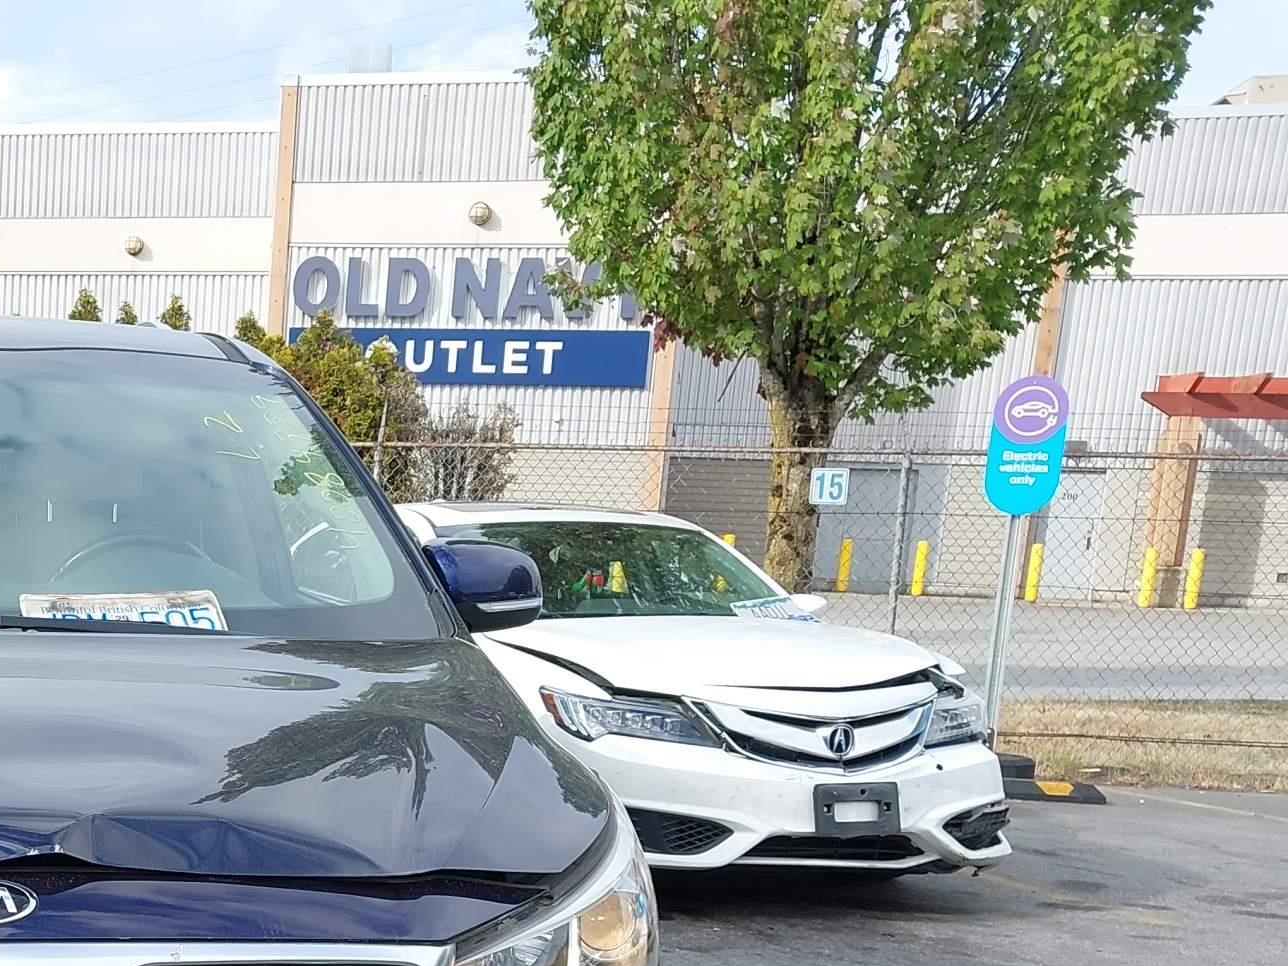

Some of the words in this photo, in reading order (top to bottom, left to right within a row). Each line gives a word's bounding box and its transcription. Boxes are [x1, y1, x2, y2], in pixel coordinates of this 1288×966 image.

[293, 256, 432, 319] OLD
[451, 257, 638, 320] NAV
[1002, 450, 1049, 462] Electric
[815, 472, 844, 500] 15
[1009, 474, 1036, 487] only
